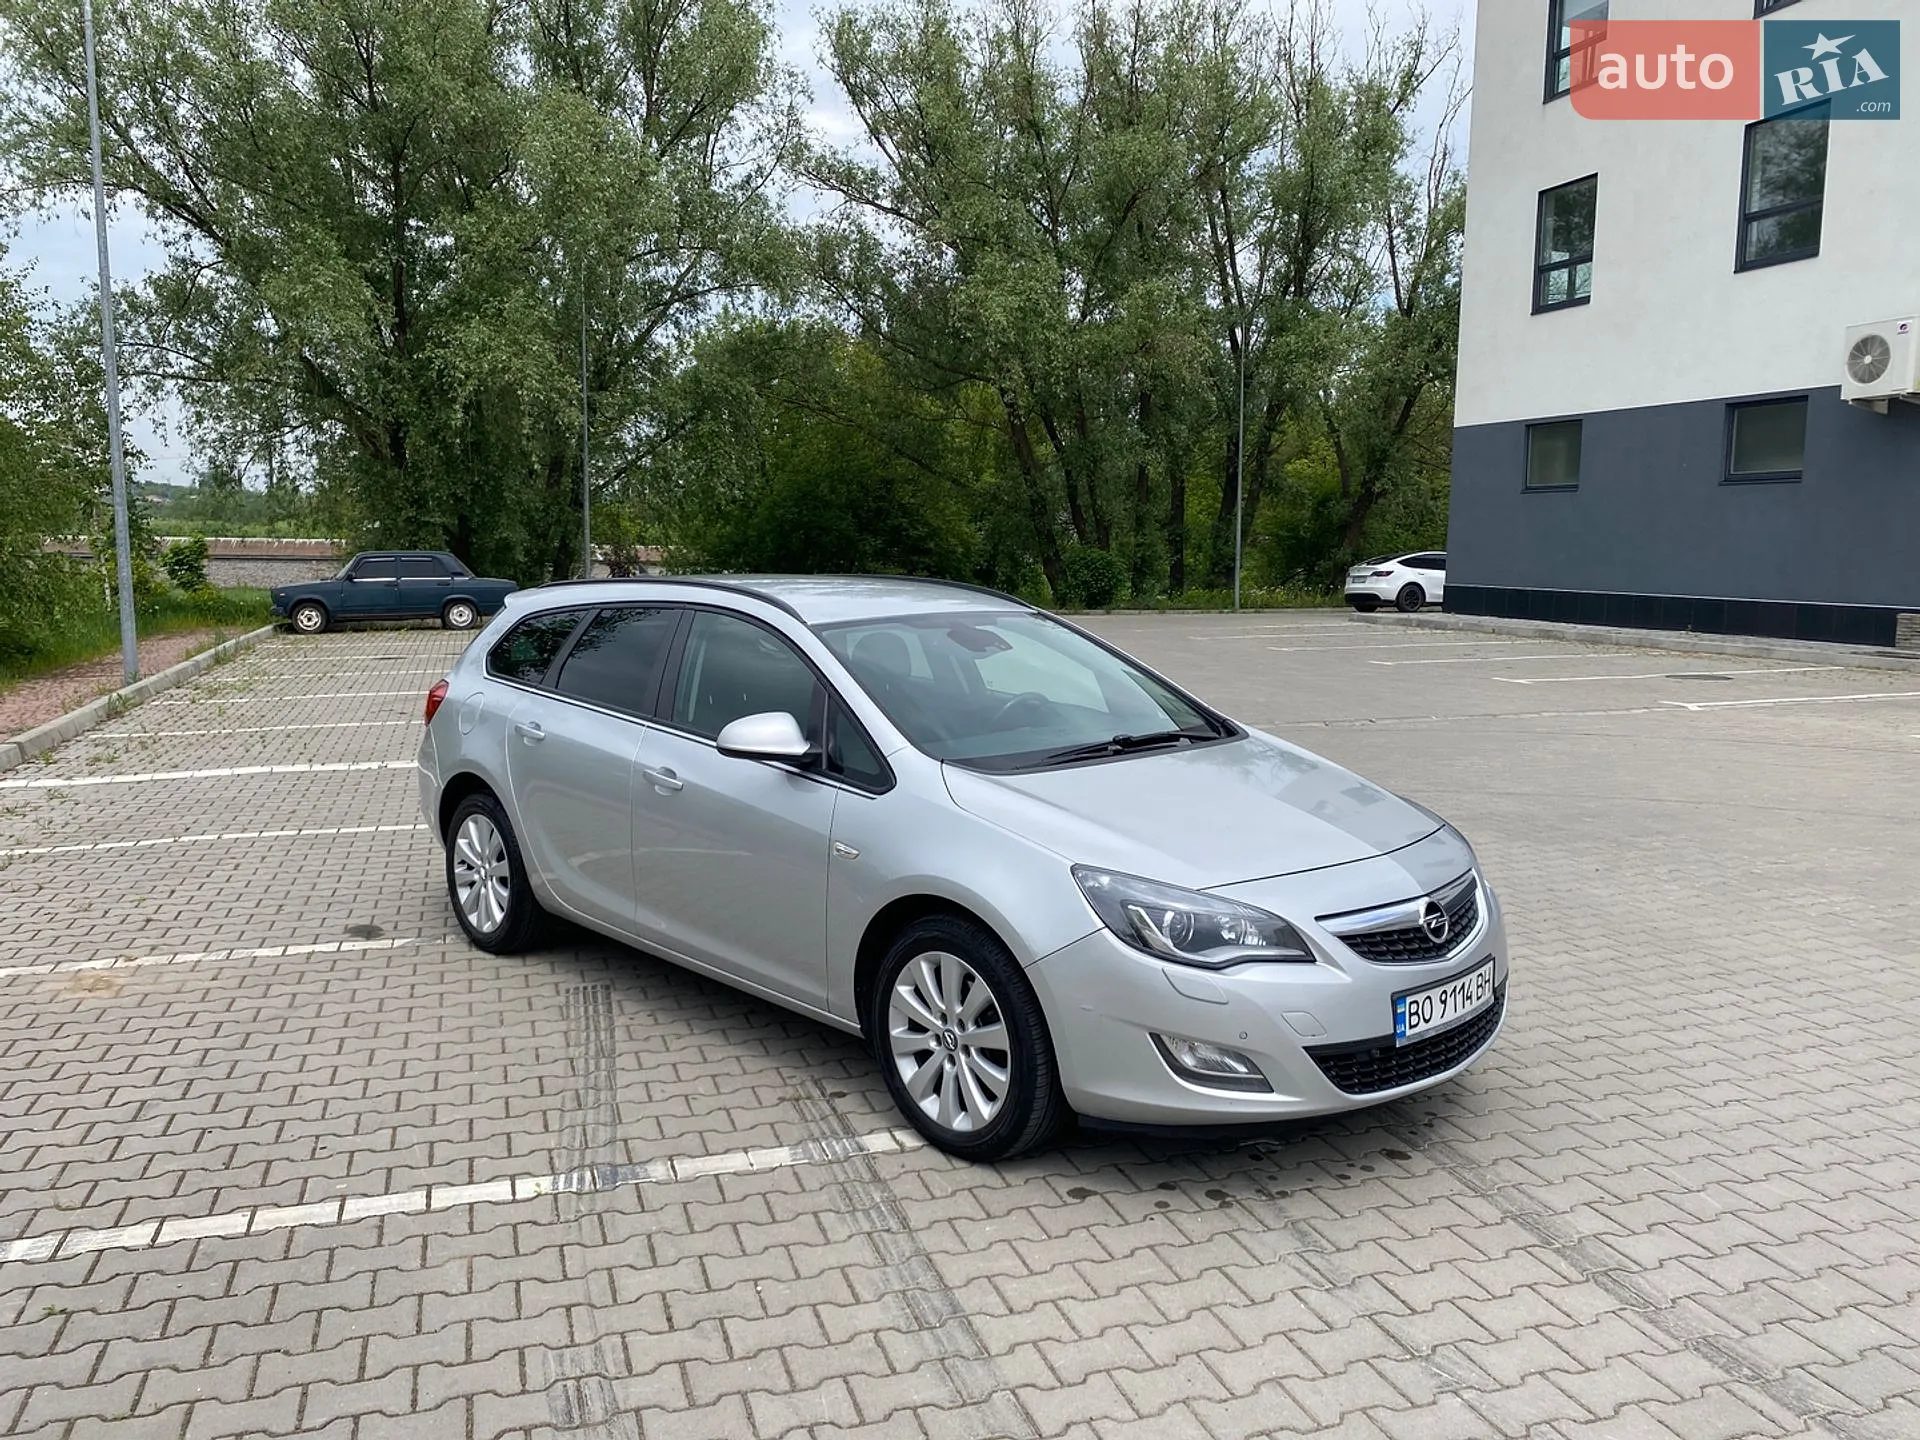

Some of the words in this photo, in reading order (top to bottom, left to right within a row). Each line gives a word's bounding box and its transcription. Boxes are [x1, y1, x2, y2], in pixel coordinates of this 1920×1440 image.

[1408, 995, 1433, 1030] BO
[1439, 978, 1474, 1019] 9114
[1475, 966, 1492, 1001] BH
